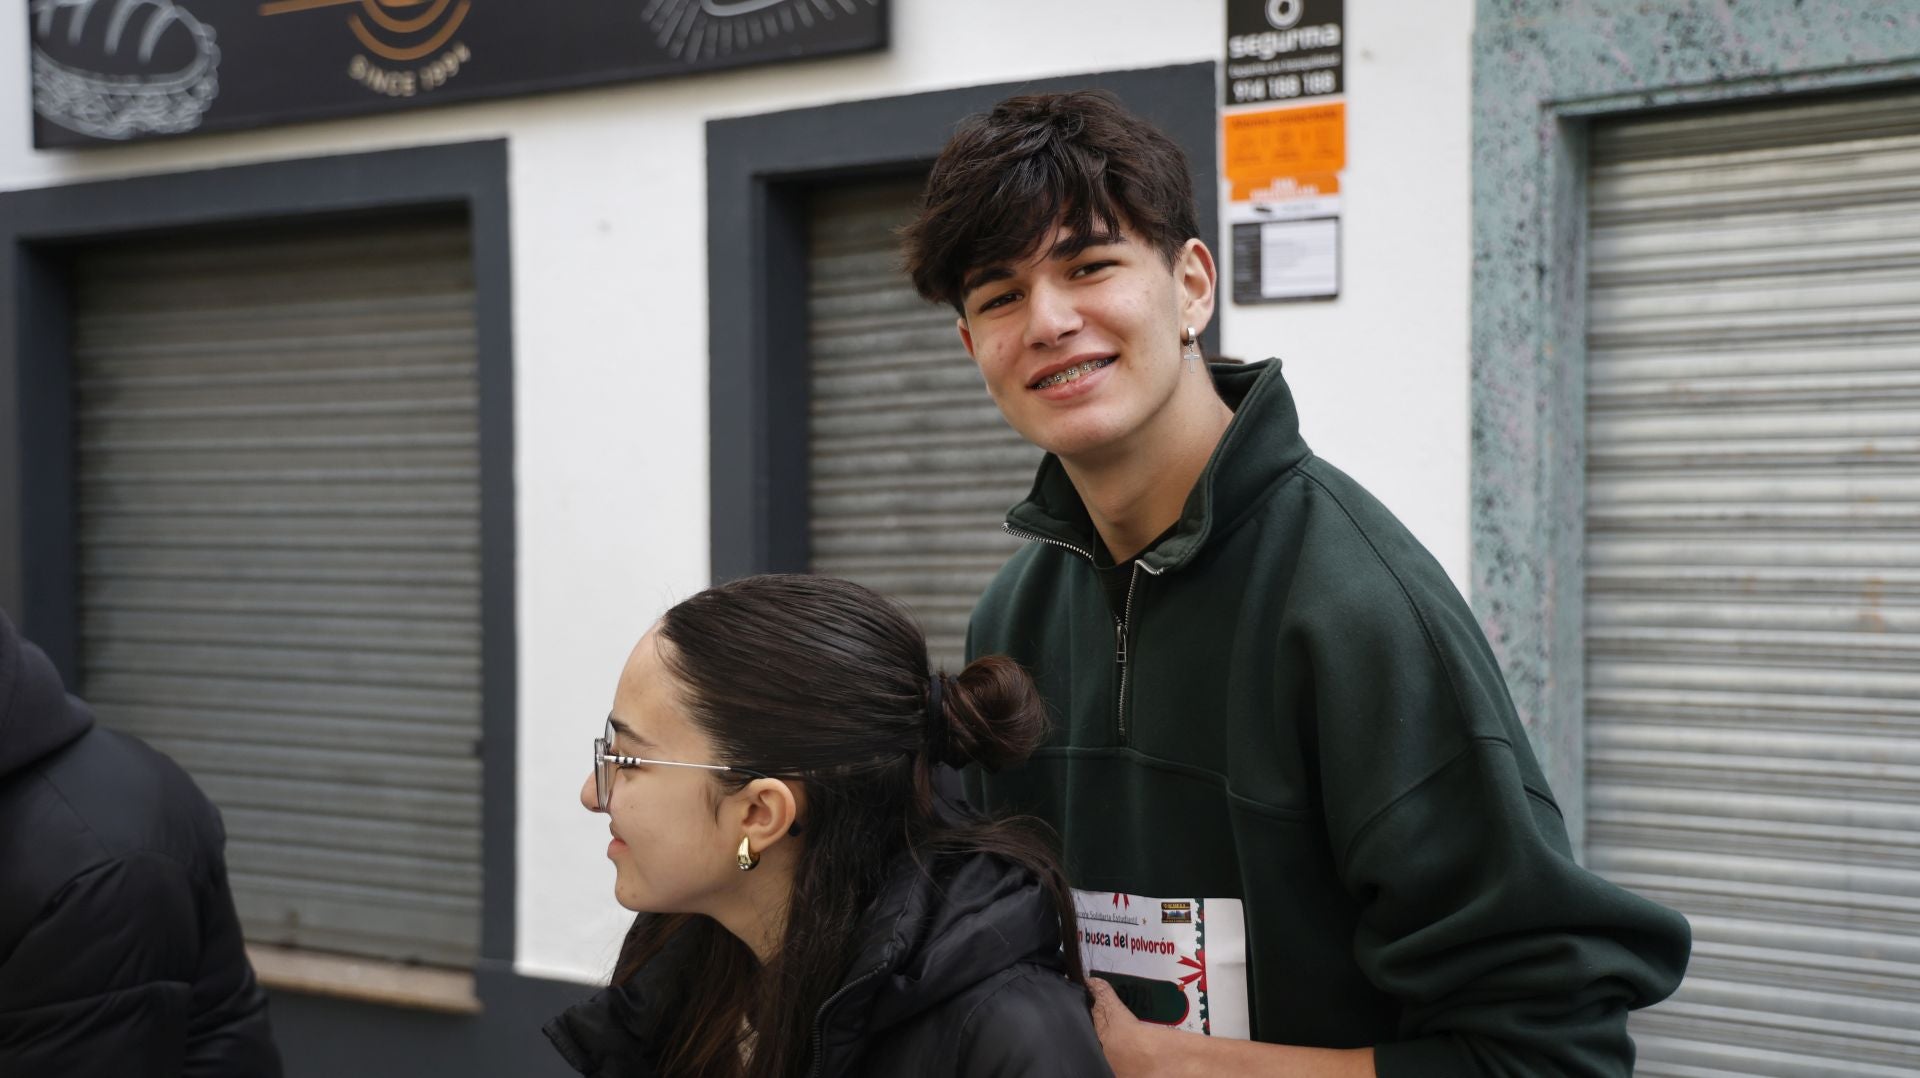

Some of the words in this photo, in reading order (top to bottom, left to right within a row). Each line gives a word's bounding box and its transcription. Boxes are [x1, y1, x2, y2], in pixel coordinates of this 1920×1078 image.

[1229, 23, 1341, 60] segurma
[349, 54, 417, 97] SINCE
[1085, 928, 1111, 948] busca
[1113, 931, 1128, 949] del
[1131, 936, 1175, 955] polvorón
